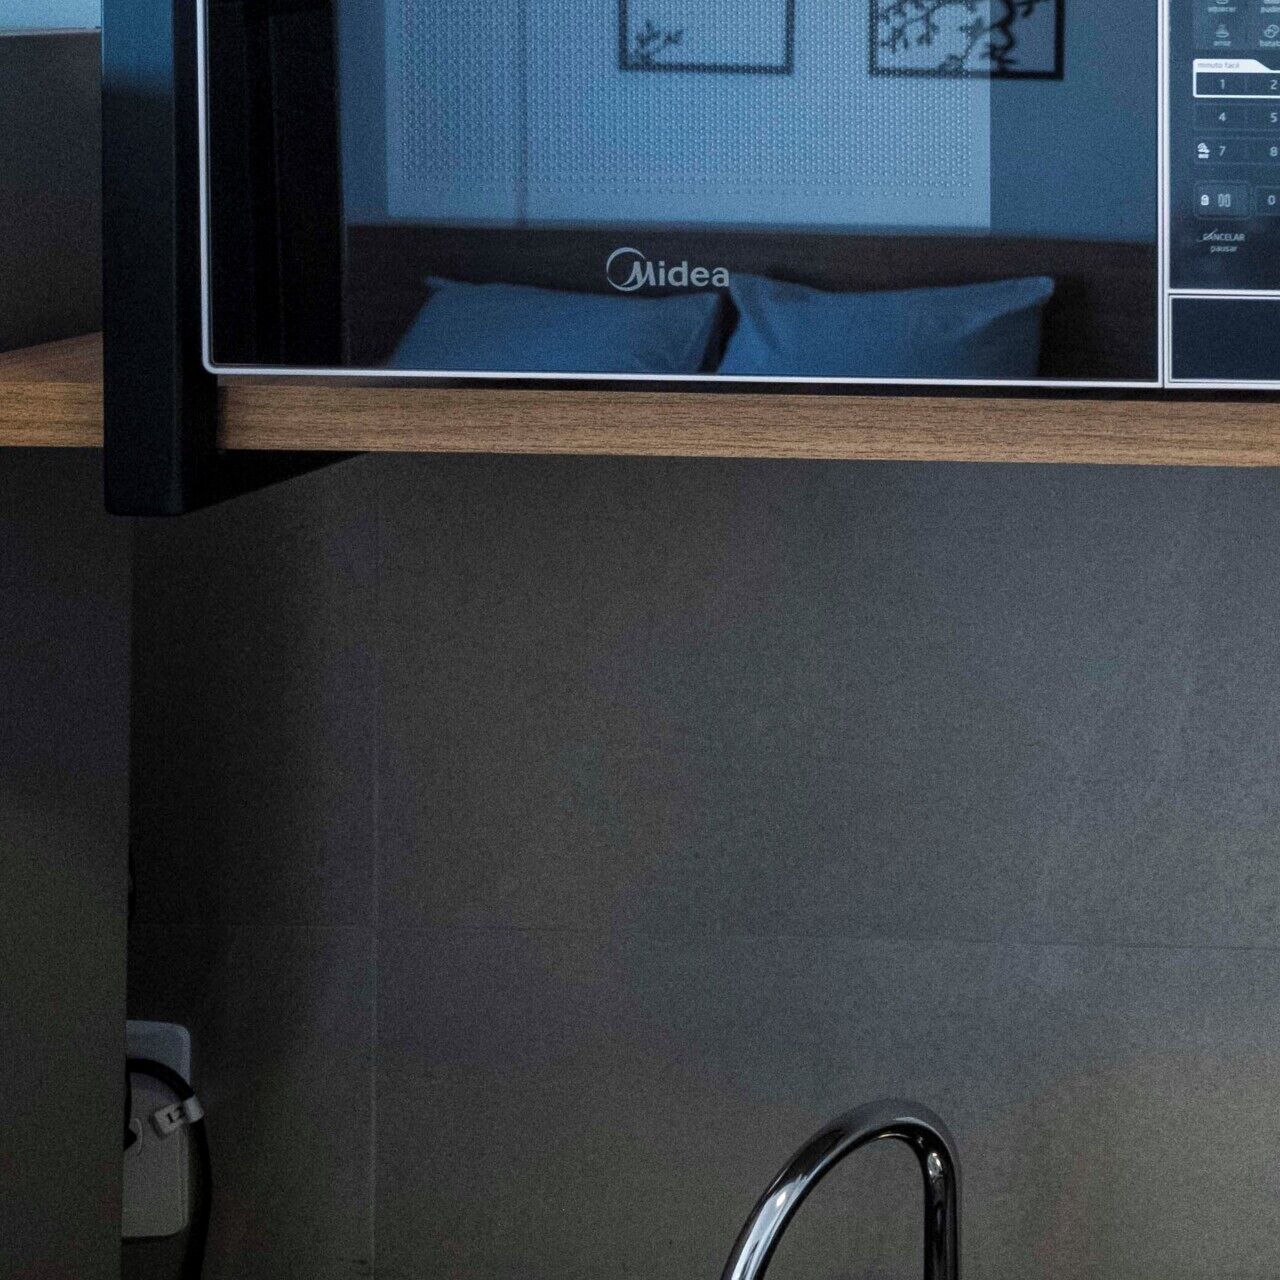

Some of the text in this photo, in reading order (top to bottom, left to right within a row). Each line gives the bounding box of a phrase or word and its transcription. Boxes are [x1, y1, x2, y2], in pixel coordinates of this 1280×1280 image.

[1219, 79, 1226, 90] 1
[1270, 80, 1278, 90] 2
[1218, 112, 1227, 122] 4
[1269, 112, 1278, 123] 5
[1219, 146, 1227, 157] 7
[1269, 146, 1278, 157] 8
[1267, 195, 1276, 206] 0
[1203, 233, 1246, 242] CANCELAR
[1210, 245, 1238, 253] pausar
[606, 247, 730, 292] Midea
